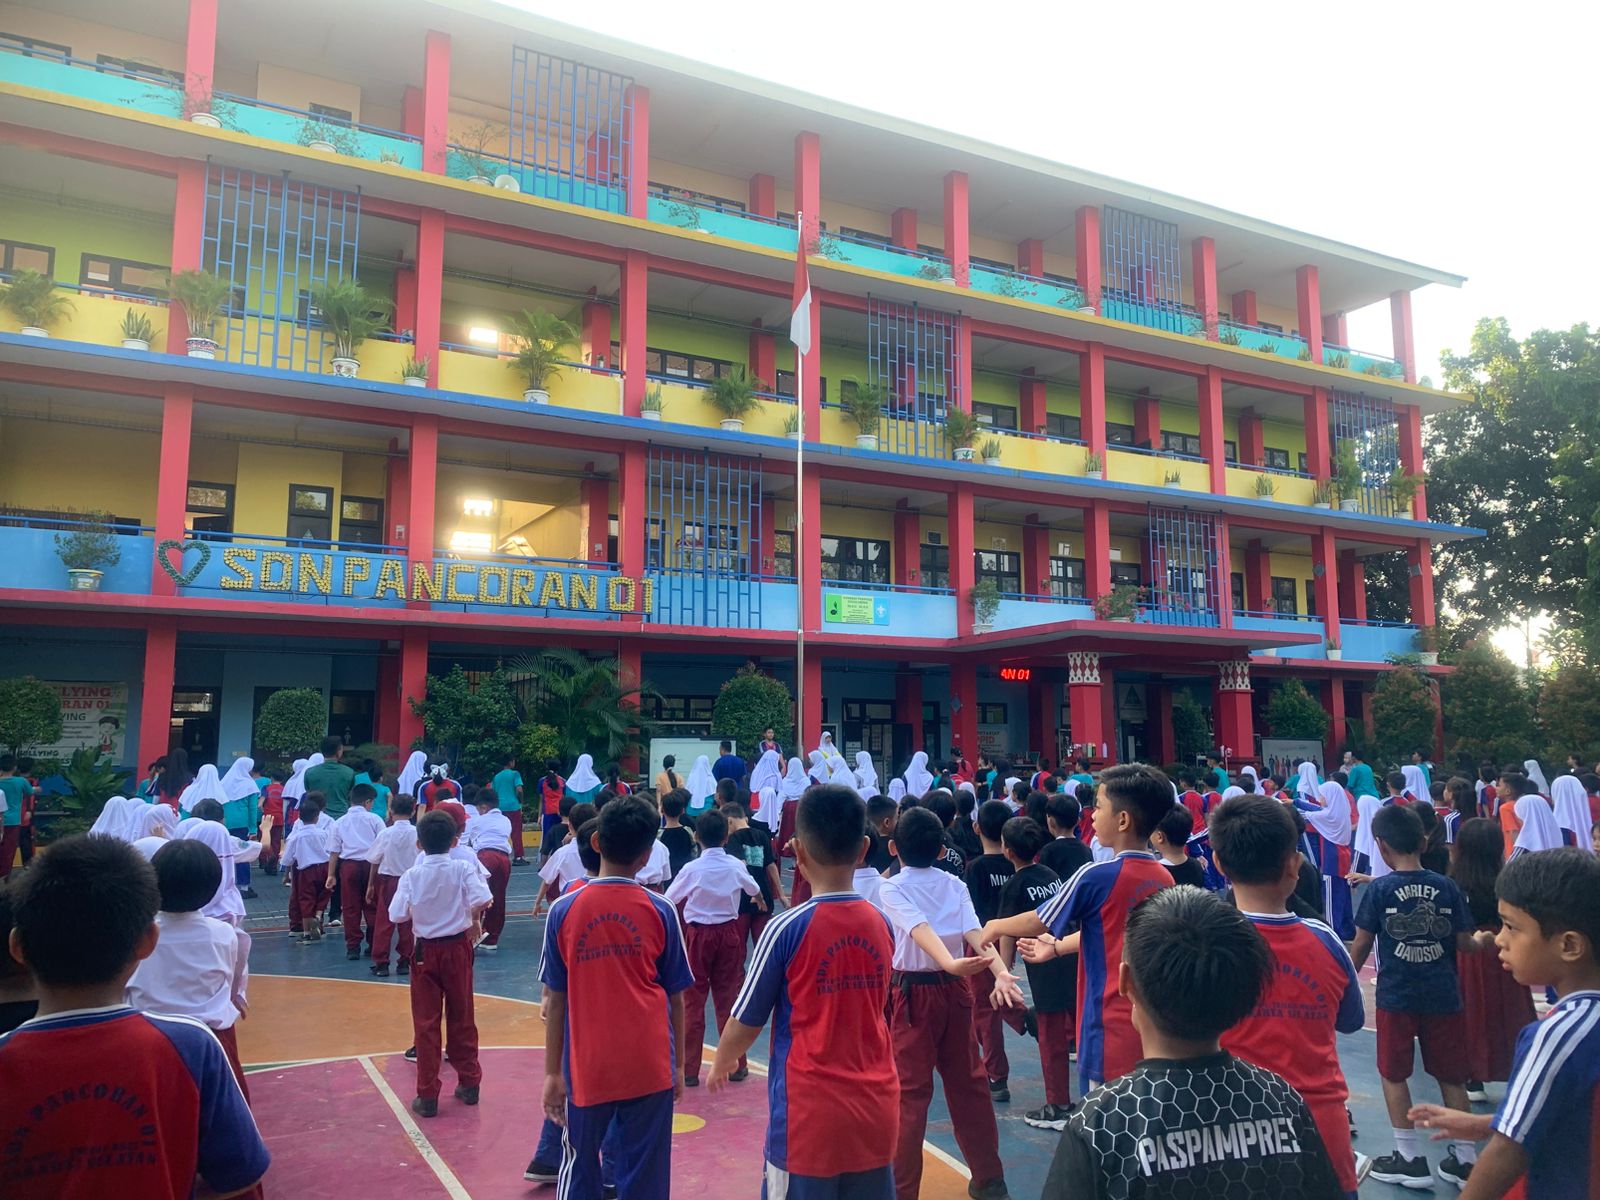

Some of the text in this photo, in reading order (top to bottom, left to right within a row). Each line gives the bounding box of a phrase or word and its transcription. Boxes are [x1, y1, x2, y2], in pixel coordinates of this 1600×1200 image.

[220, 547, 333, 594] SDN
[343, 556, 598, 610] PANCORAN
[61, 686, 113, 698] LYING
[989, 873, 1014, 887] MIK
[1394, 884, 1440, 902] HARLEY
[1393, 941, 1445, 963] DAVIDSON
